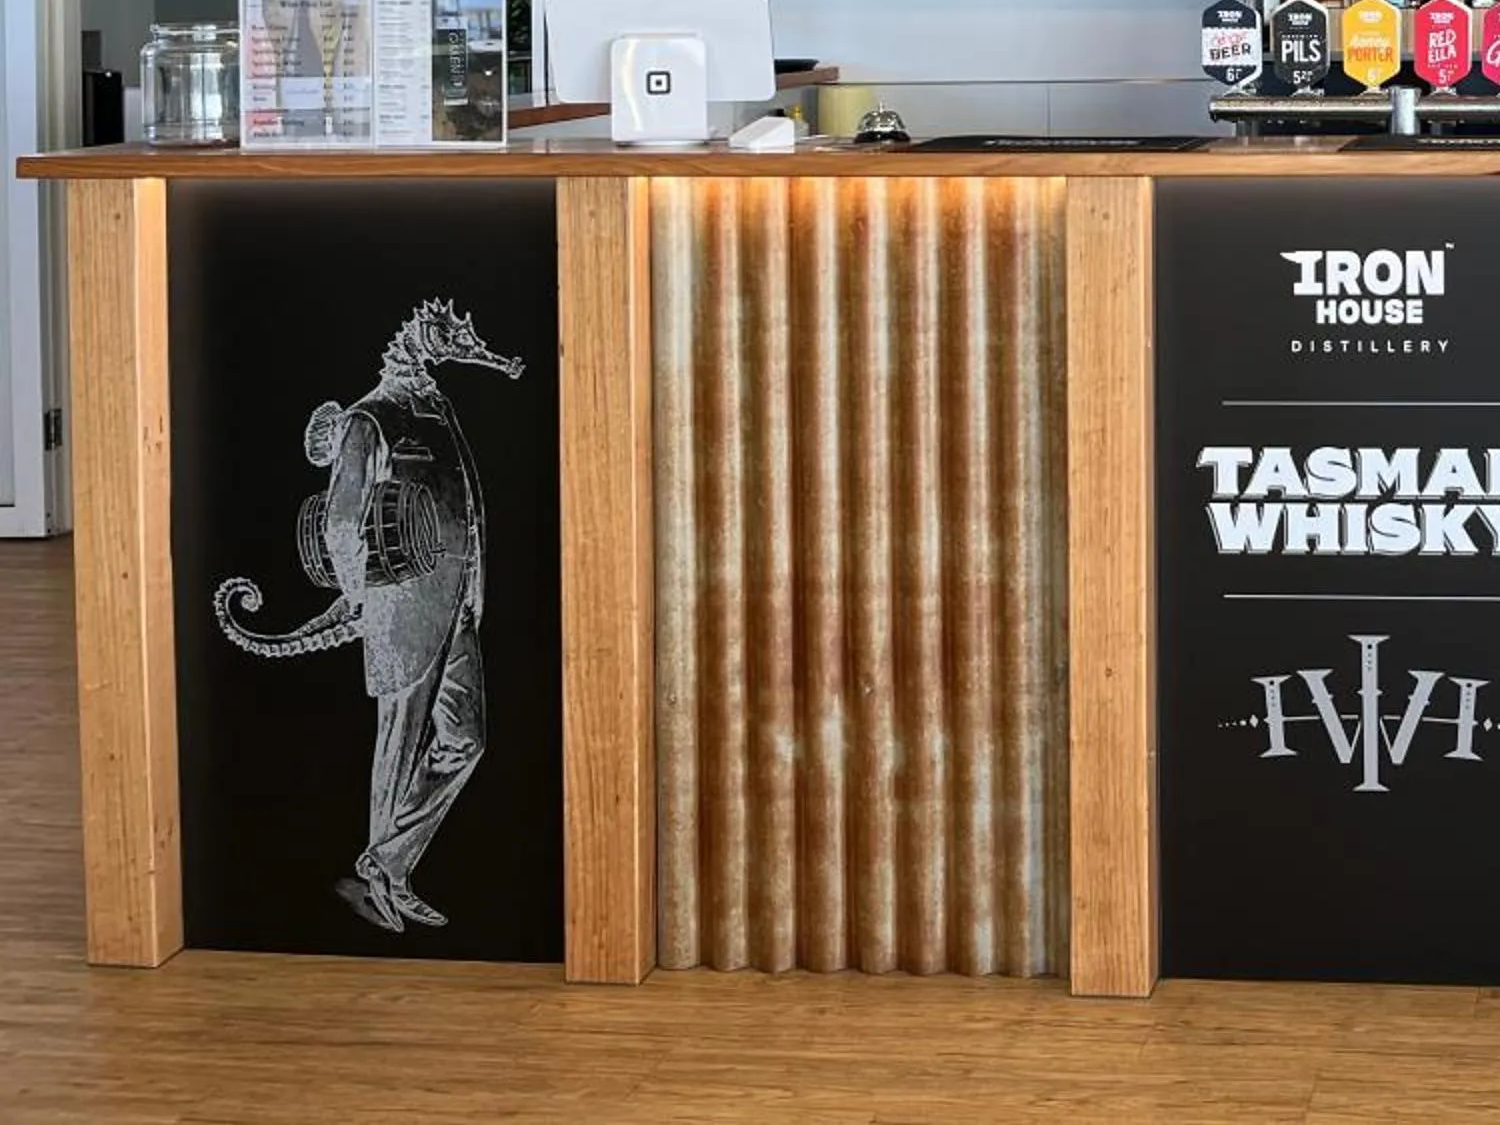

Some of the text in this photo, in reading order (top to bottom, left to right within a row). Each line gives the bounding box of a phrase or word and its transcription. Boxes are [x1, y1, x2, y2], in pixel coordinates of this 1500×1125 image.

[1429, 28, 1457, 48] RED
[1209, 42, 1251, 60] BEER
[1281, 39, 1321, 63] PILS
[1347, 46, 1393, 63] PORTER
[1428, 46, 1457, 64] ELLA
[1279, 249, 1445, 296] IRON
[1316, 299, 1424, 325] HOUSE
[1291, 340, 1449, 353] DISTILLERY
